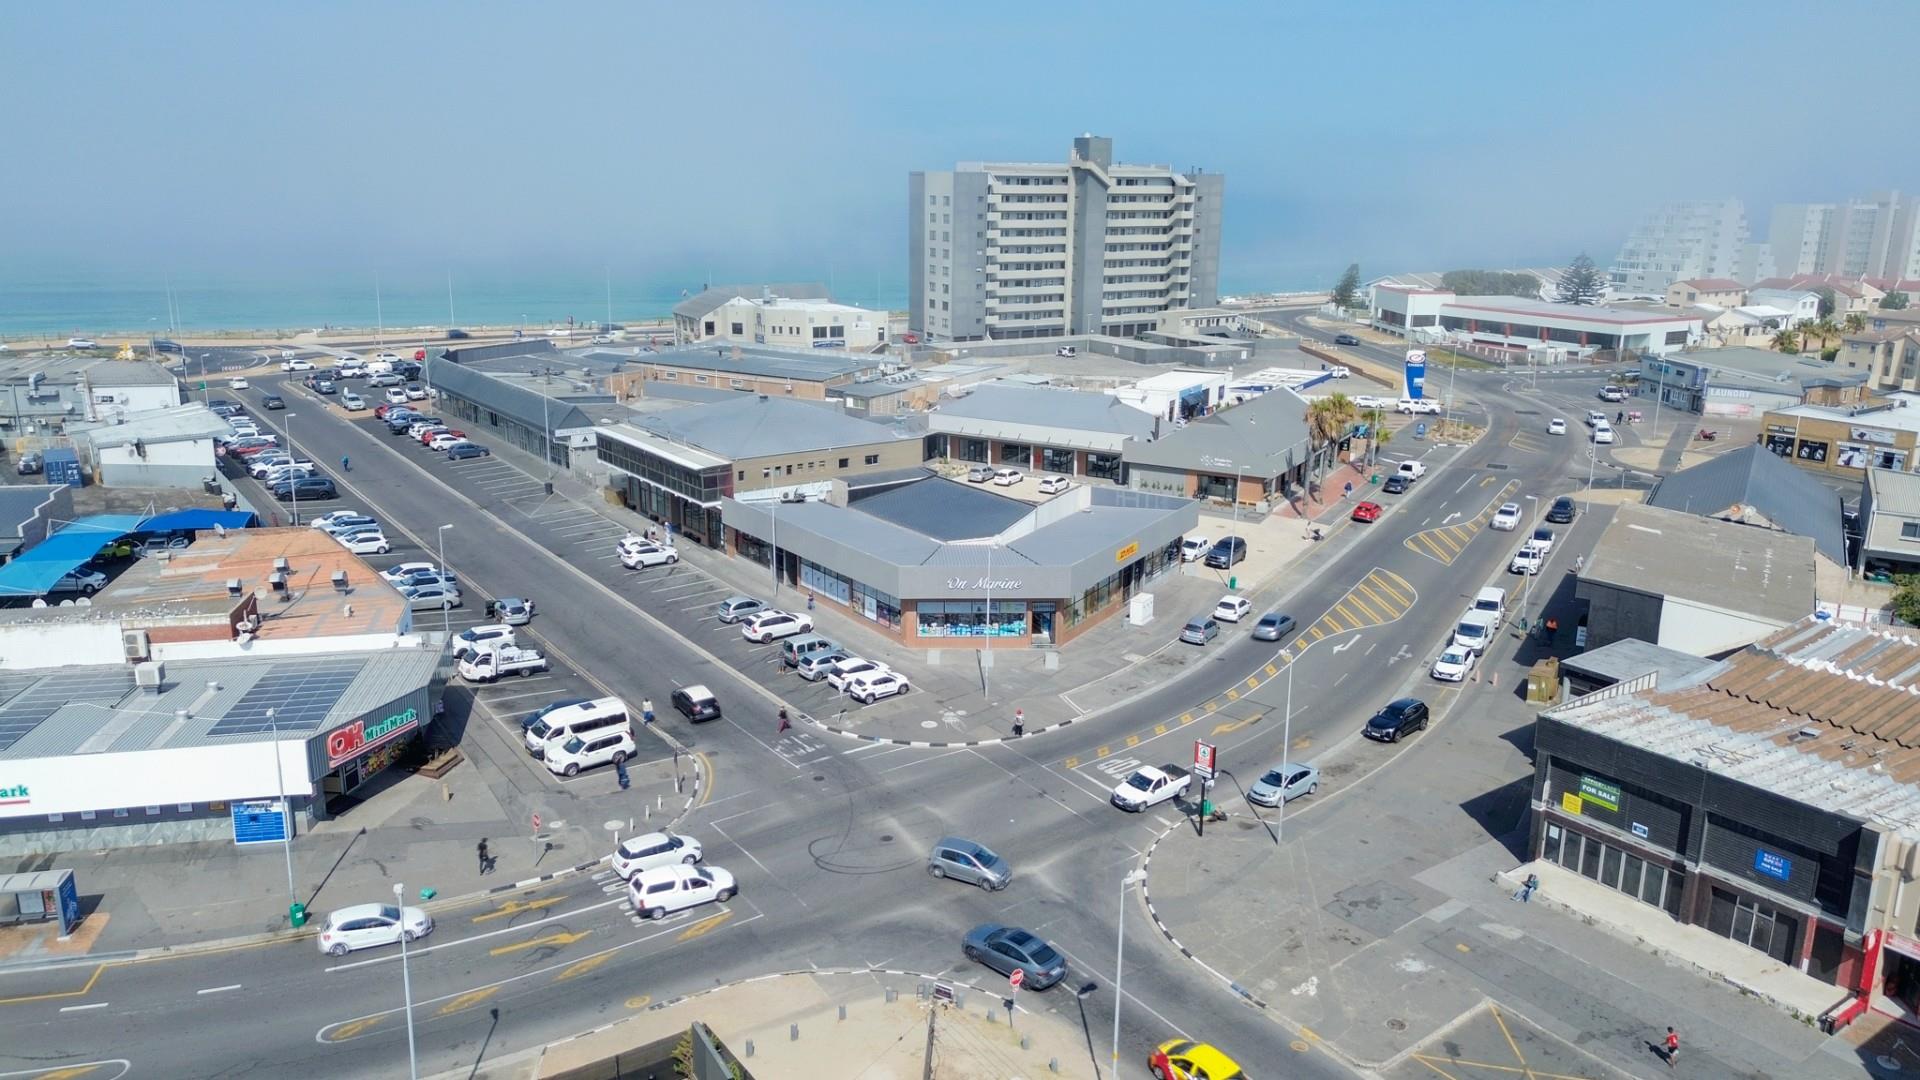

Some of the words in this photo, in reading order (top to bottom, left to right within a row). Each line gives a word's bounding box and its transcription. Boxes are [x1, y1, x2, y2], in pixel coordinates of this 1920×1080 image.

[947, 576, 969, 590] On
[971, 576, 1023, 590] Marine
[328, 720, 365, 759] OK
[364, 708, 417, 742] MiniMark
[1096, 757, 1142, 780] TOP
[1581, 784, 1597, 794] FOR
[1597, 789, 1617, 802] SALE
